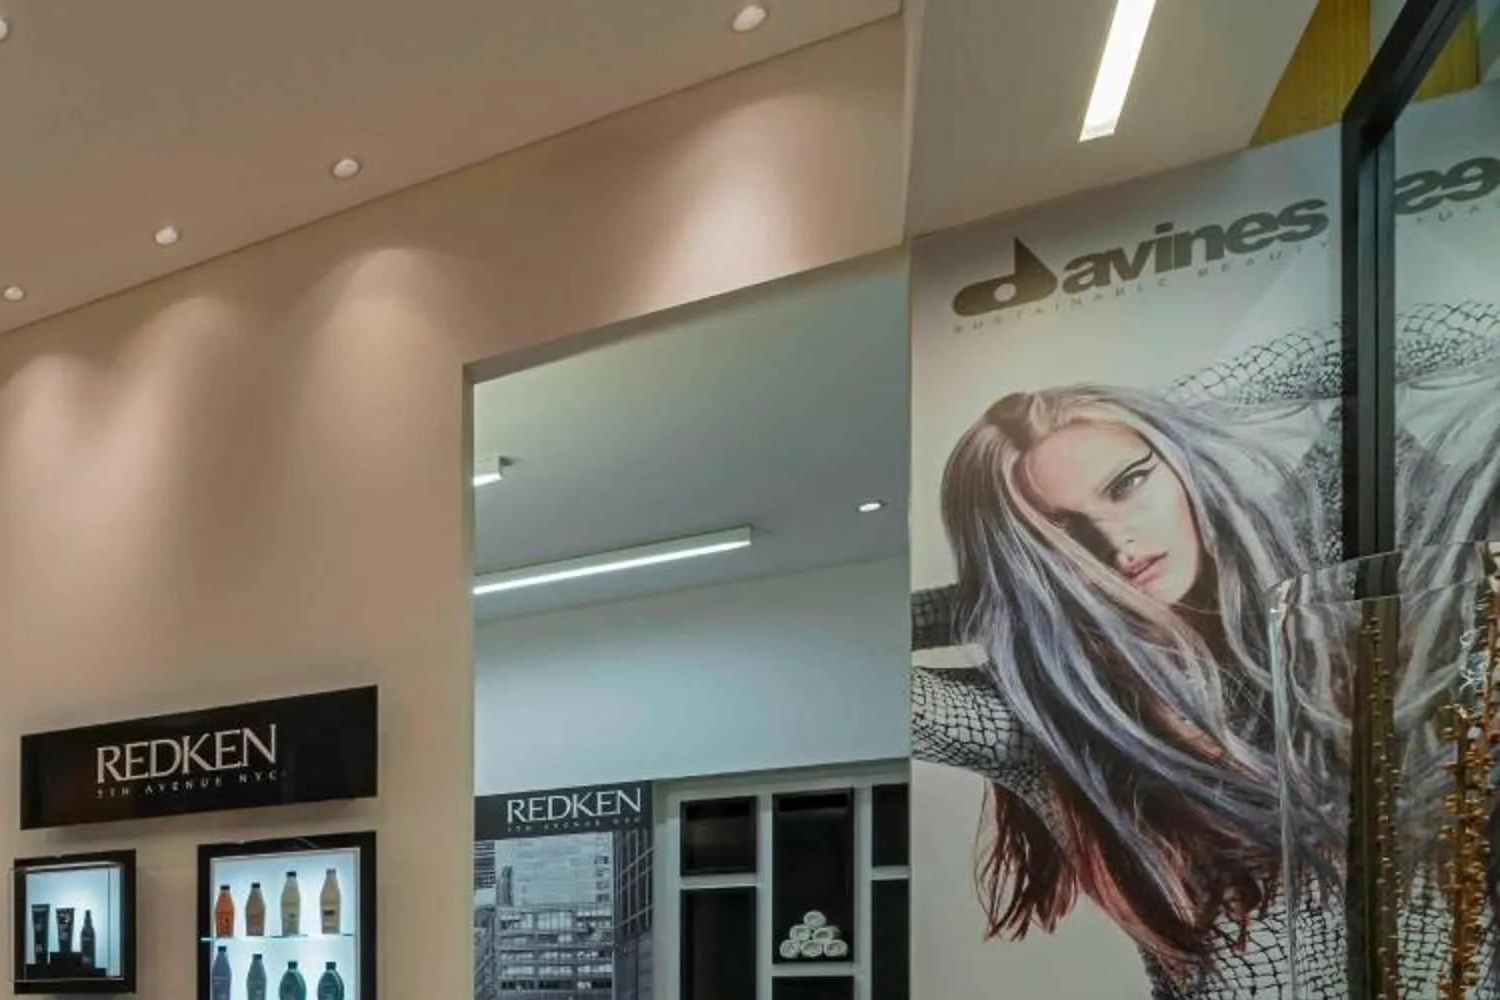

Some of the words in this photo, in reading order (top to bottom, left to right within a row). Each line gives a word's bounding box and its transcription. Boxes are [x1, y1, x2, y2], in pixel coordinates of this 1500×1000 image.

[953, 199, 1329, 316] davines
[97, 723, 278, 784] REDKEN
[507, 787, 641, 824] REDKEN
